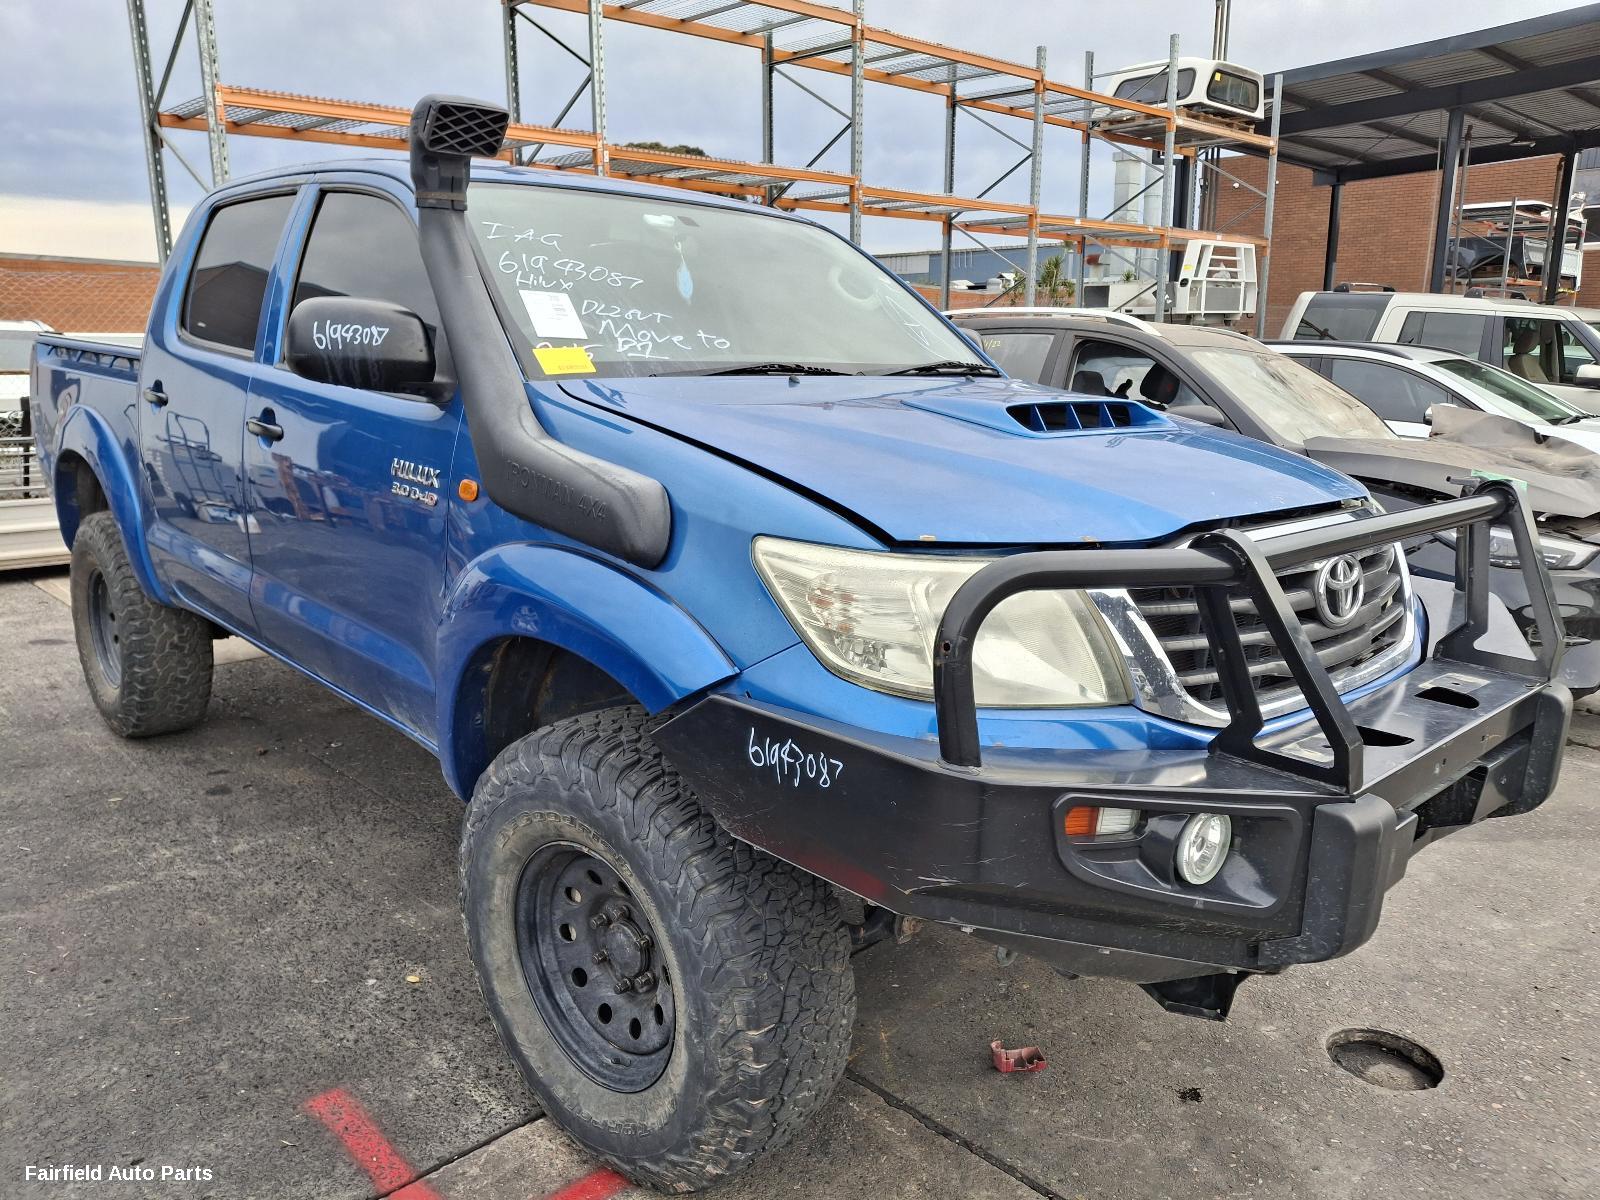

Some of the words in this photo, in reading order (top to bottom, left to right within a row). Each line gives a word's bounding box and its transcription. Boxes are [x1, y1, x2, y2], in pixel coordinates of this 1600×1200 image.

[482, 221, 563, 251] IAG
[516, 271, 573, 290] Hilux
[313, 320, 389, 350] 61943087
[391, 458, 440, 489] HILUX
[749, 727, 843, 788] 61943087
